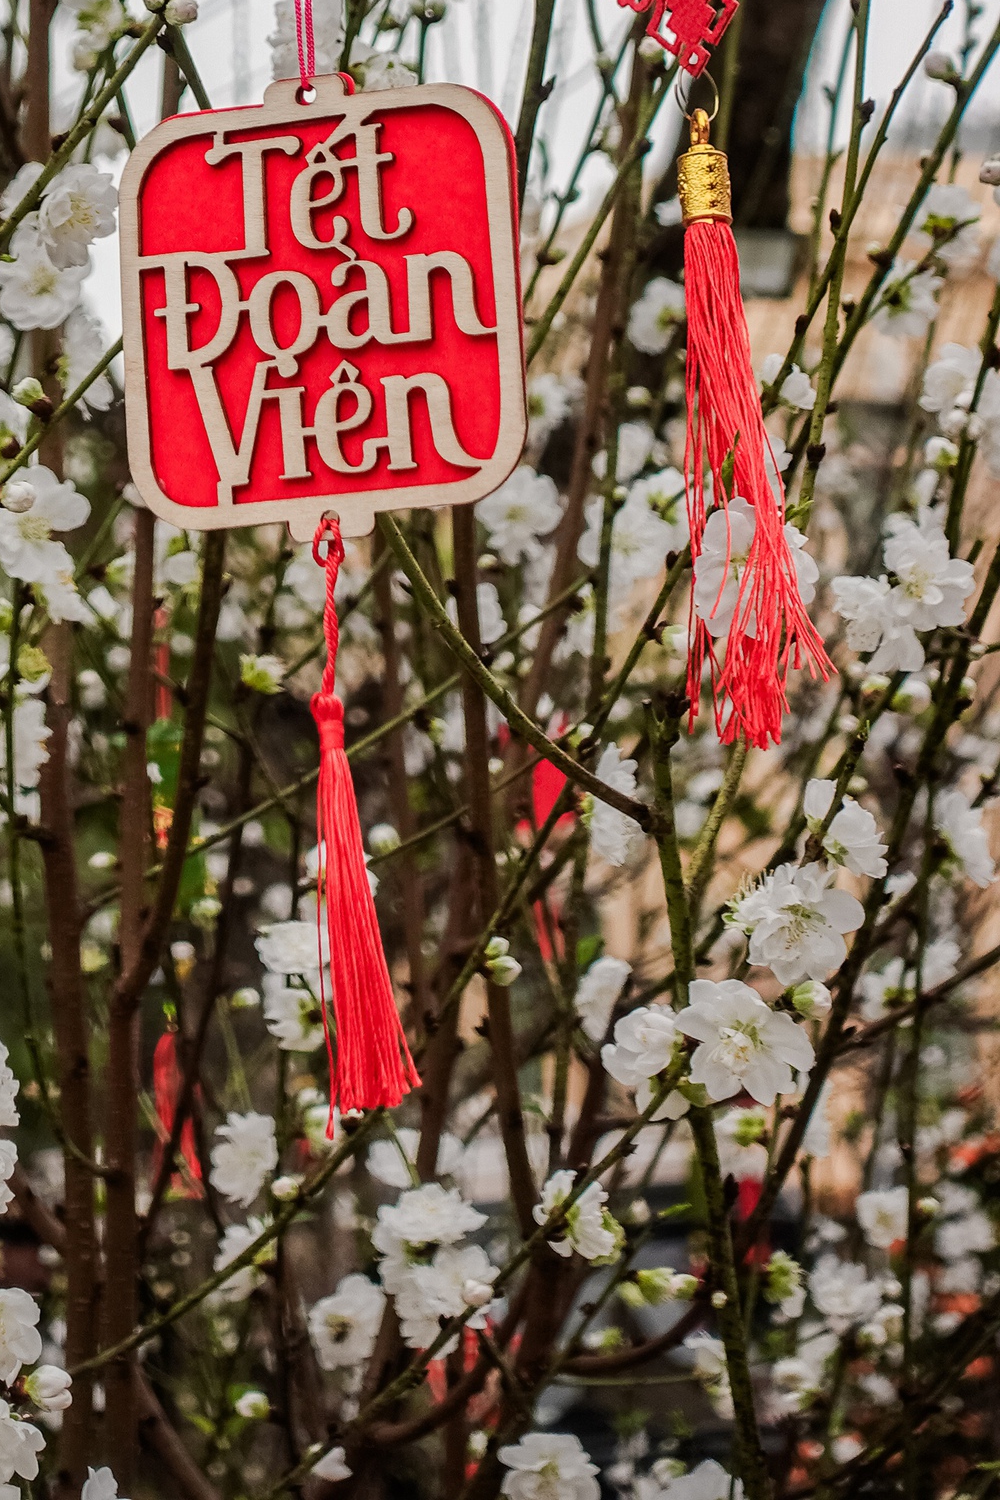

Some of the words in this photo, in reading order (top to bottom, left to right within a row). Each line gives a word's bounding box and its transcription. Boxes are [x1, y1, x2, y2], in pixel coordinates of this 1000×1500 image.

[204, 118, 416, 258] Tết
[153, 251, 498, 372] Đoàn
[187, 359, 494, 497] Viên
